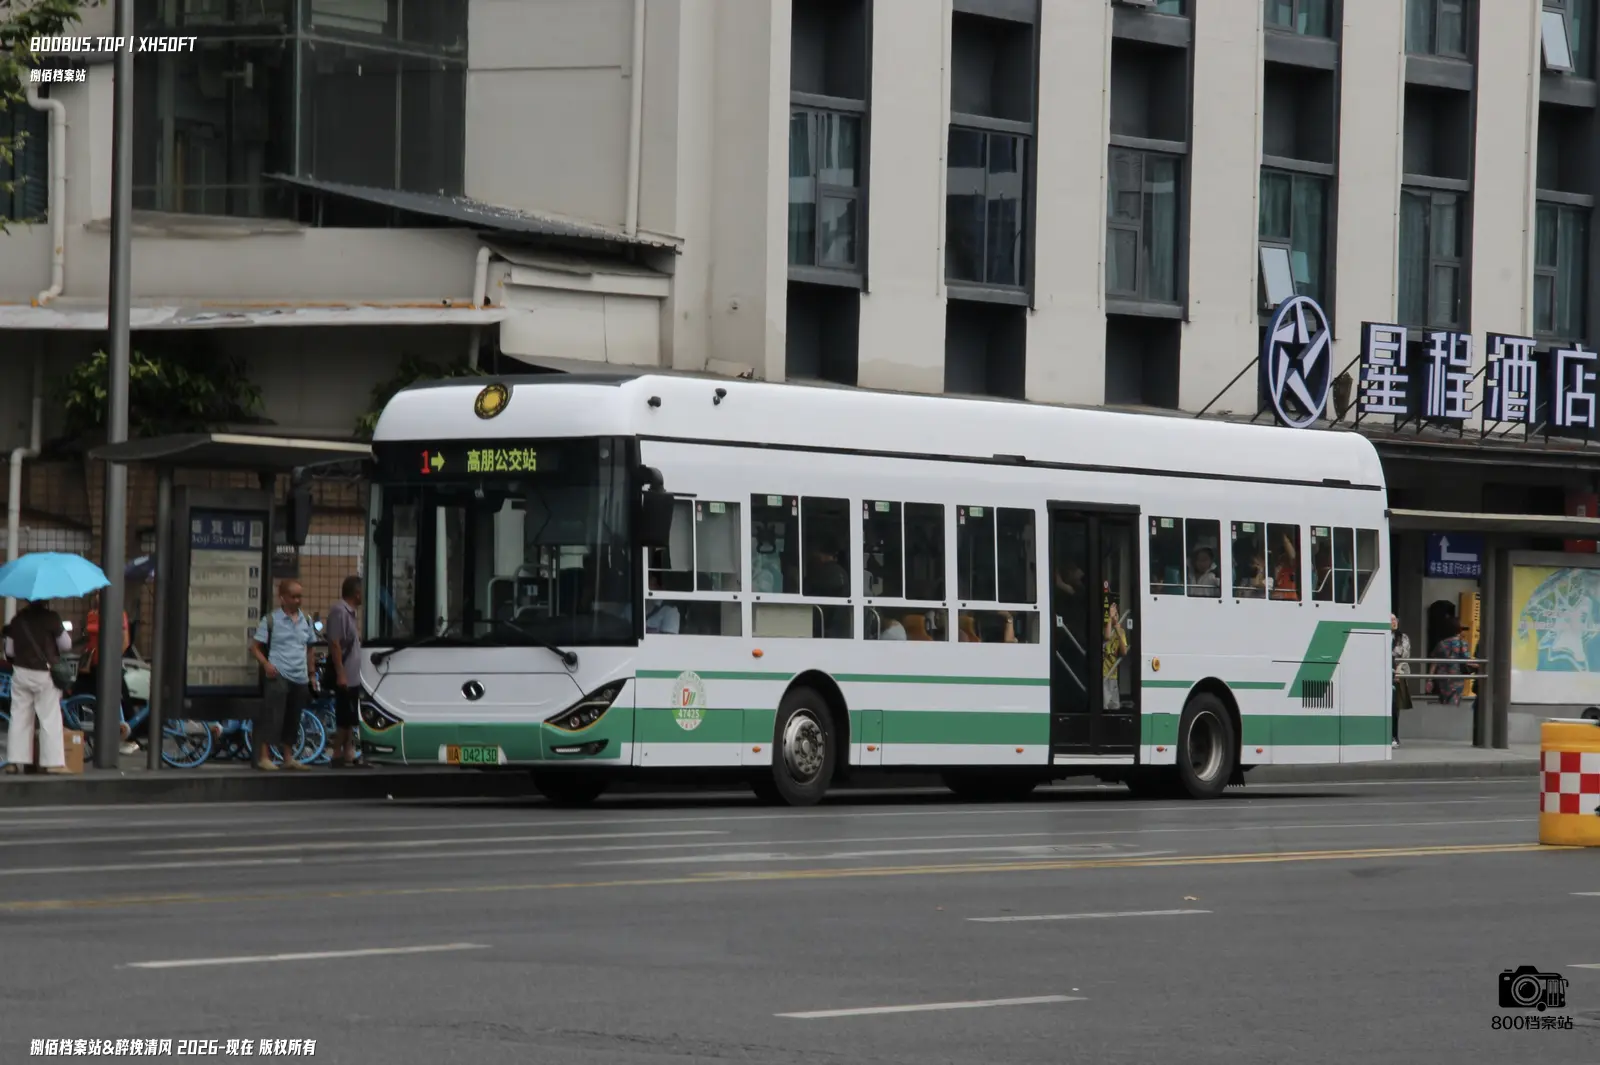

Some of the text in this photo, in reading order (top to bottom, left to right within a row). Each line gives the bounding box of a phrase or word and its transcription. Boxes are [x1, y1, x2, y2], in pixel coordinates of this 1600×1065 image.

[1365, 323, 1598, 428] 星程酒店
[421, 450, 430, 474] 1
[467, 448, 537, 472] 高朋公交站
